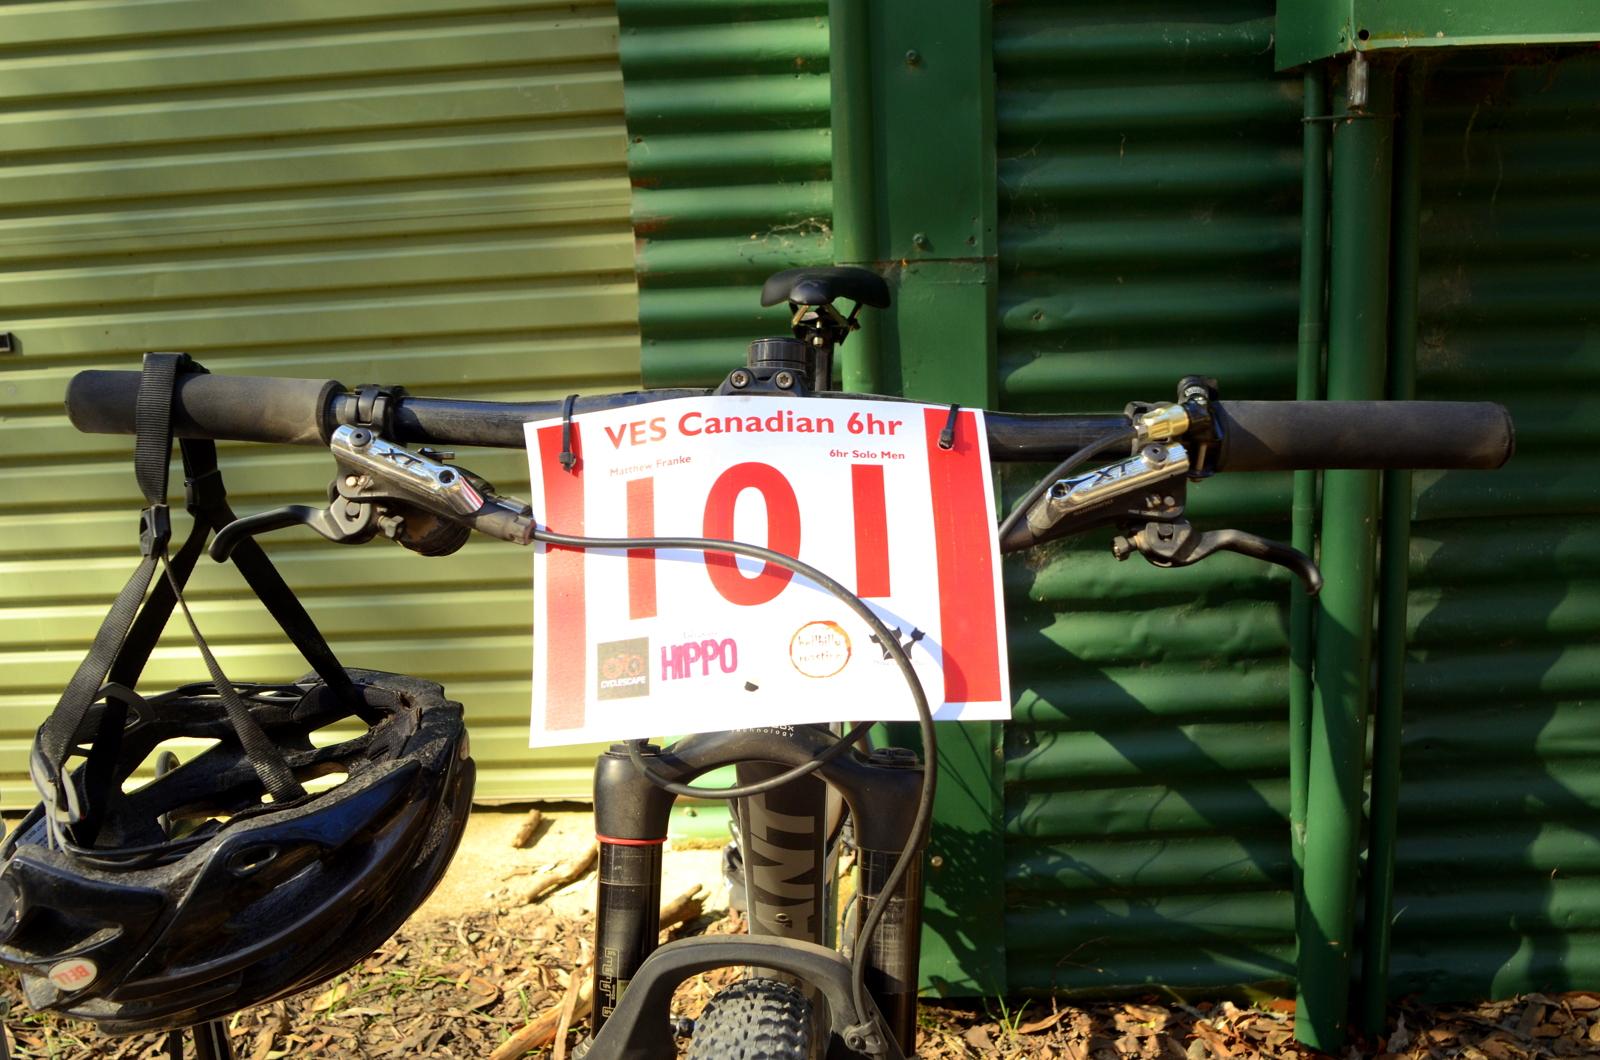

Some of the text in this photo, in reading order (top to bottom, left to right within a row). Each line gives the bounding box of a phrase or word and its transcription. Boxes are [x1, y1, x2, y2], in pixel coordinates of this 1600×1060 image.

[604, 410, 903, 449] VES Canadian 6hr
[377, 447, 425, 466] XT
[829, 449, 905, 460] 6hr Solo Men
[609, 455, 692, 477] Matthew Franke
[1091, 456, 1140, 487] XT
[626, 462, 891, 620] 101
[661, 638, 738, 681] HIPPO
[600, 675, 646, 689] CYCLESCAPE
[54, 964, 91, 985] BELL
